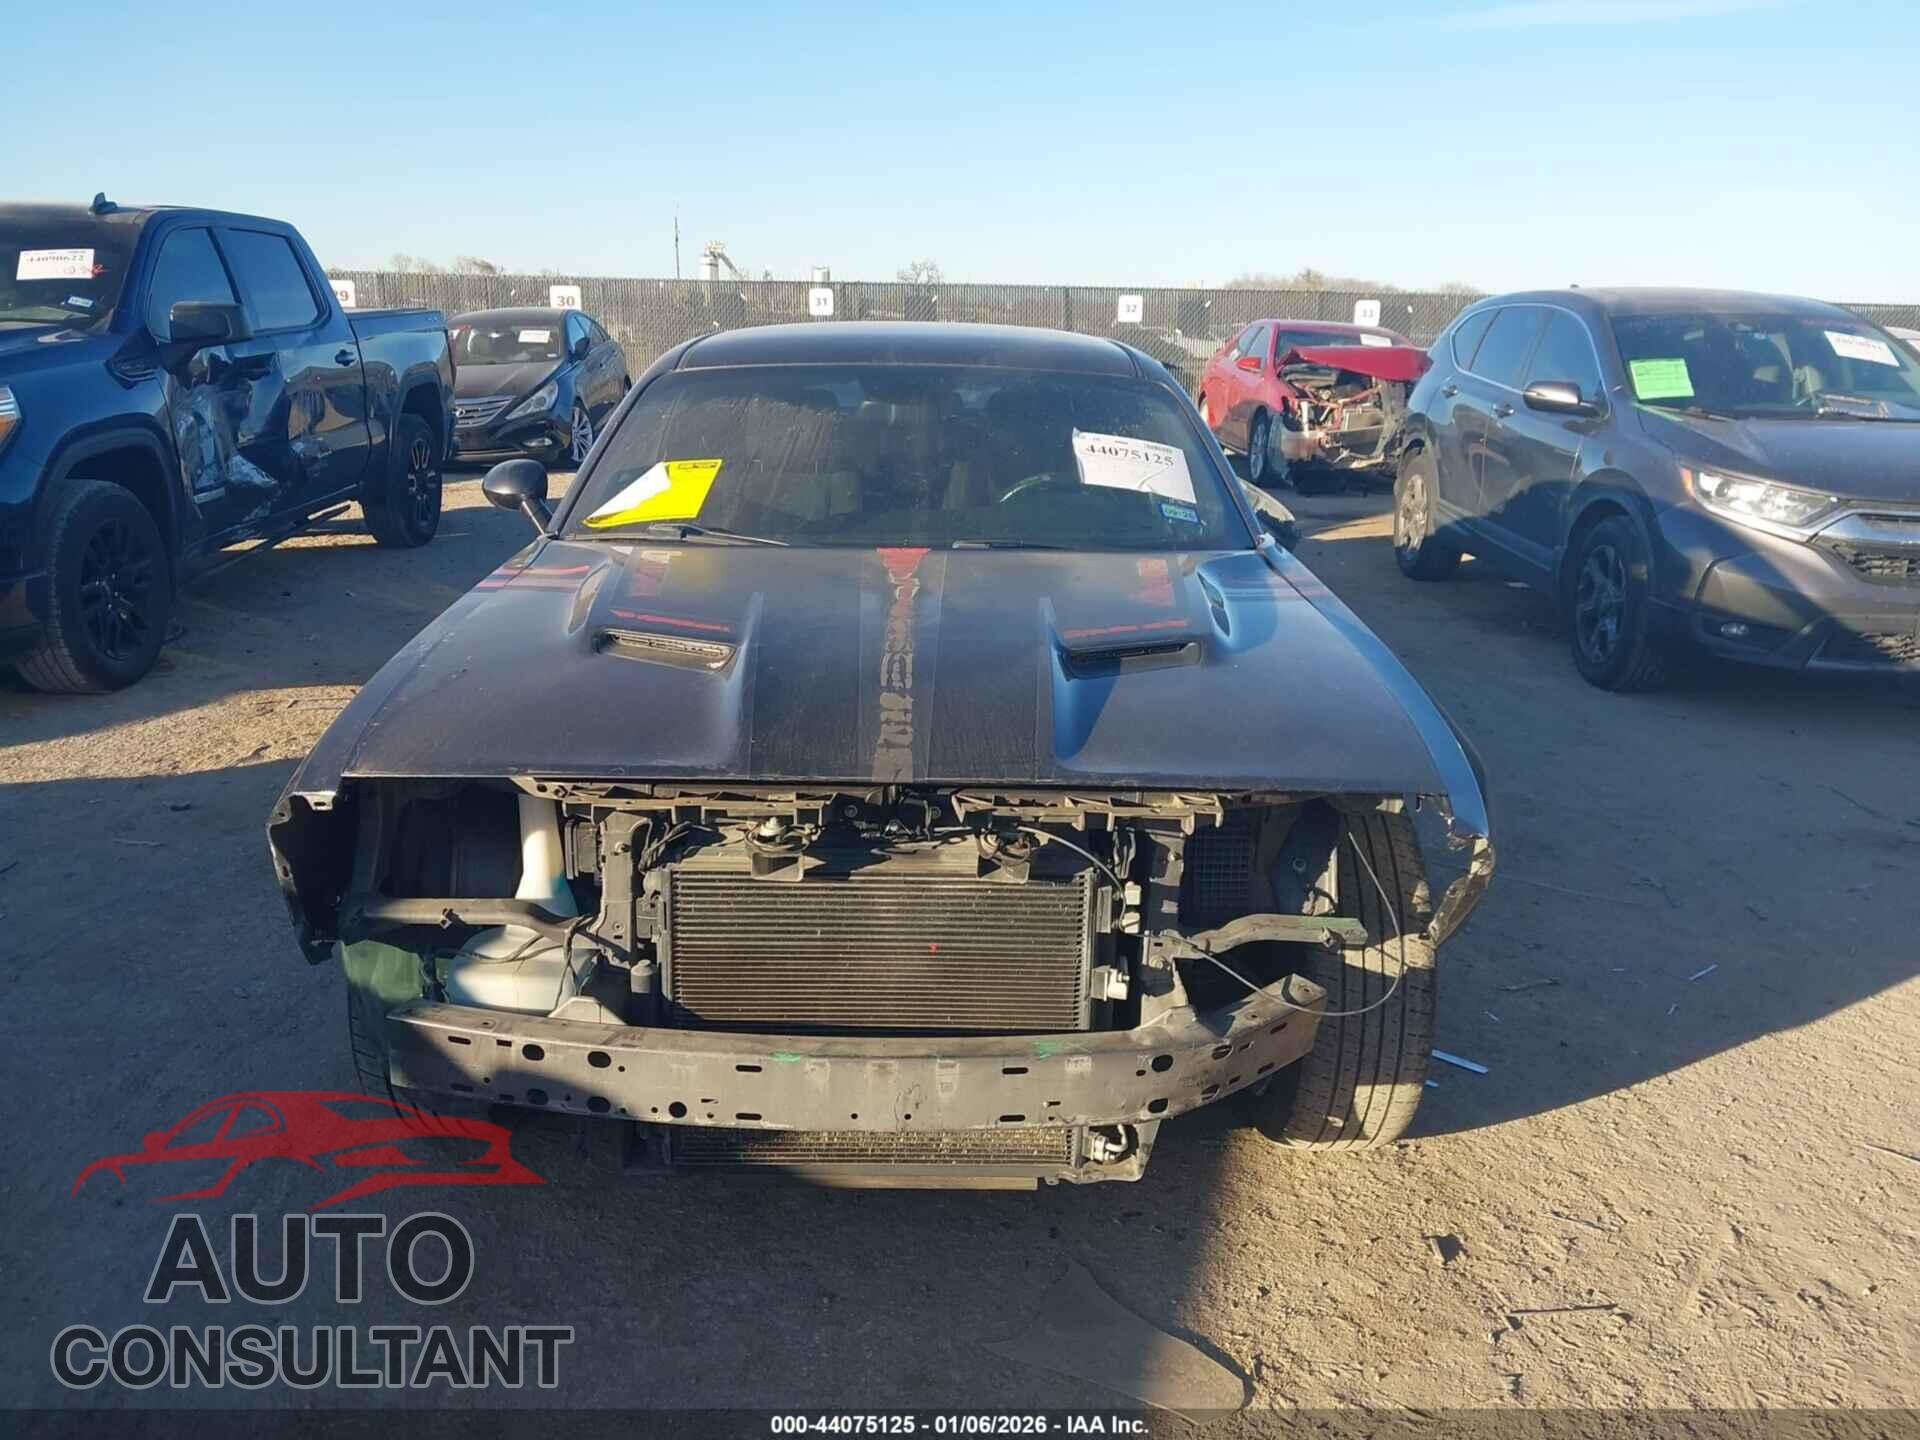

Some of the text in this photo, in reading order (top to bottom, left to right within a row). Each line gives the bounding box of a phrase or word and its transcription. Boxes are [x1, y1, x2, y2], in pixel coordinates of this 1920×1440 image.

[555, 295, 576, 307] 30
[815, 296, 828, 307] 31
[1086, 443, 1175, 467] 44075125
